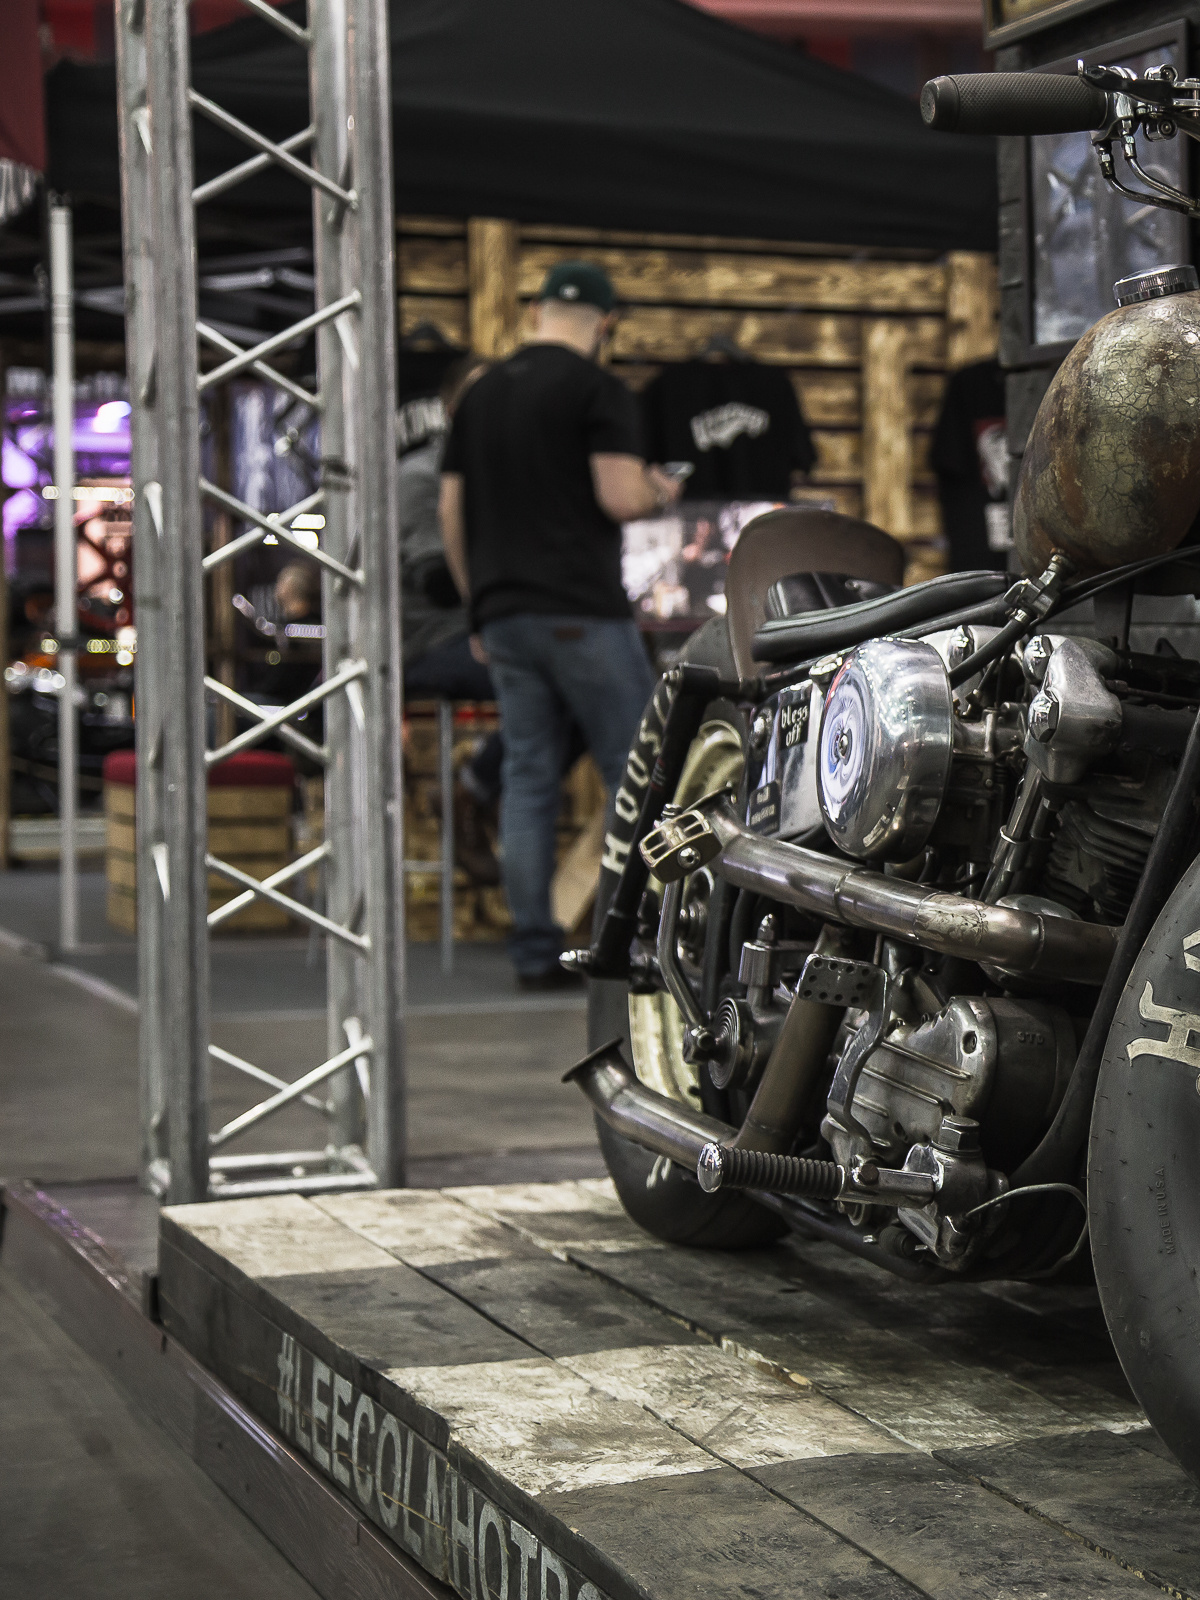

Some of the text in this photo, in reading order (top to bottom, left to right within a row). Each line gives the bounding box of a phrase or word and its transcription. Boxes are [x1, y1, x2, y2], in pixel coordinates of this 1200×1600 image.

[781, 705, 809, 729] bless
[785, 723, 802, 747] off
[1158, 1218, 1177, 1256] MADE
[277, 1332, 600, 1600] #LEECOLNHOT
